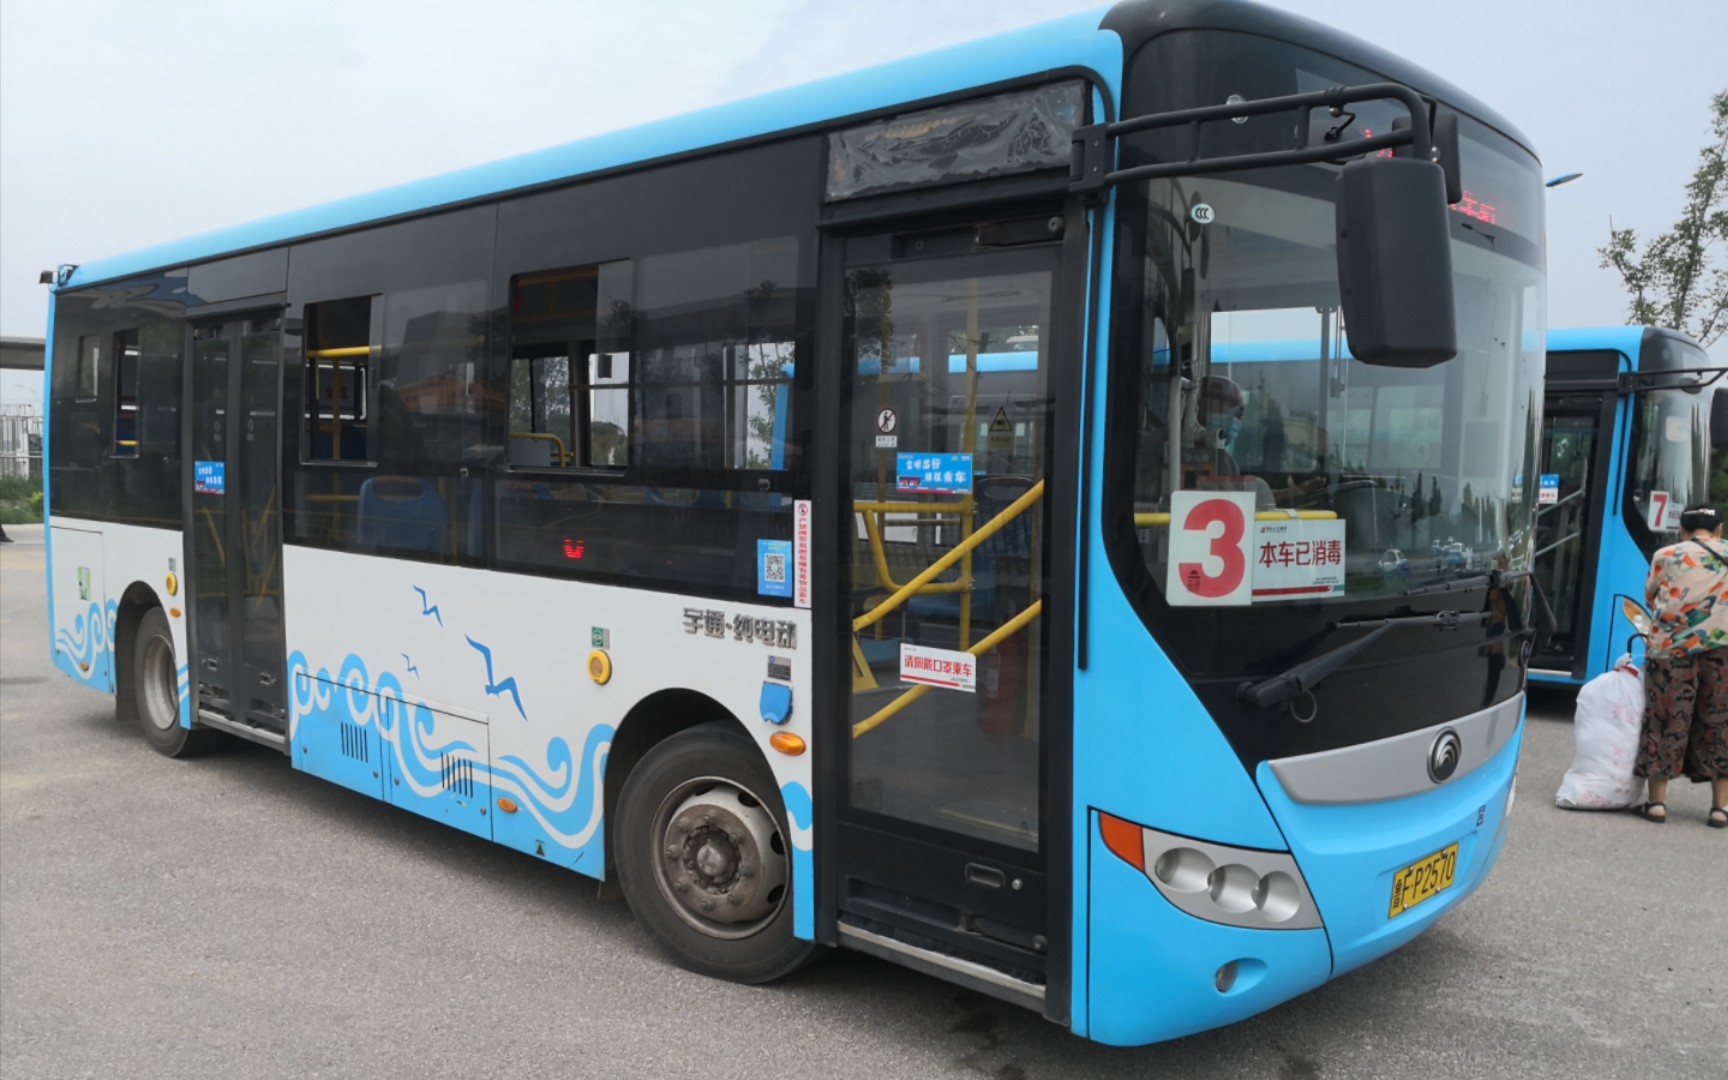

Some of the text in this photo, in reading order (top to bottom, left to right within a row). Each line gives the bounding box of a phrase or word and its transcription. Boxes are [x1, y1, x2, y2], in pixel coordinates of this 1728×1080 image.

[1653, 493, 1668, 528] 7
[1179, 499, 1245, 597] 3
[1259, 540, 1341, 568] 本车已消毒
[905, 654, 972, 677] 请佩戴口罩乘车
